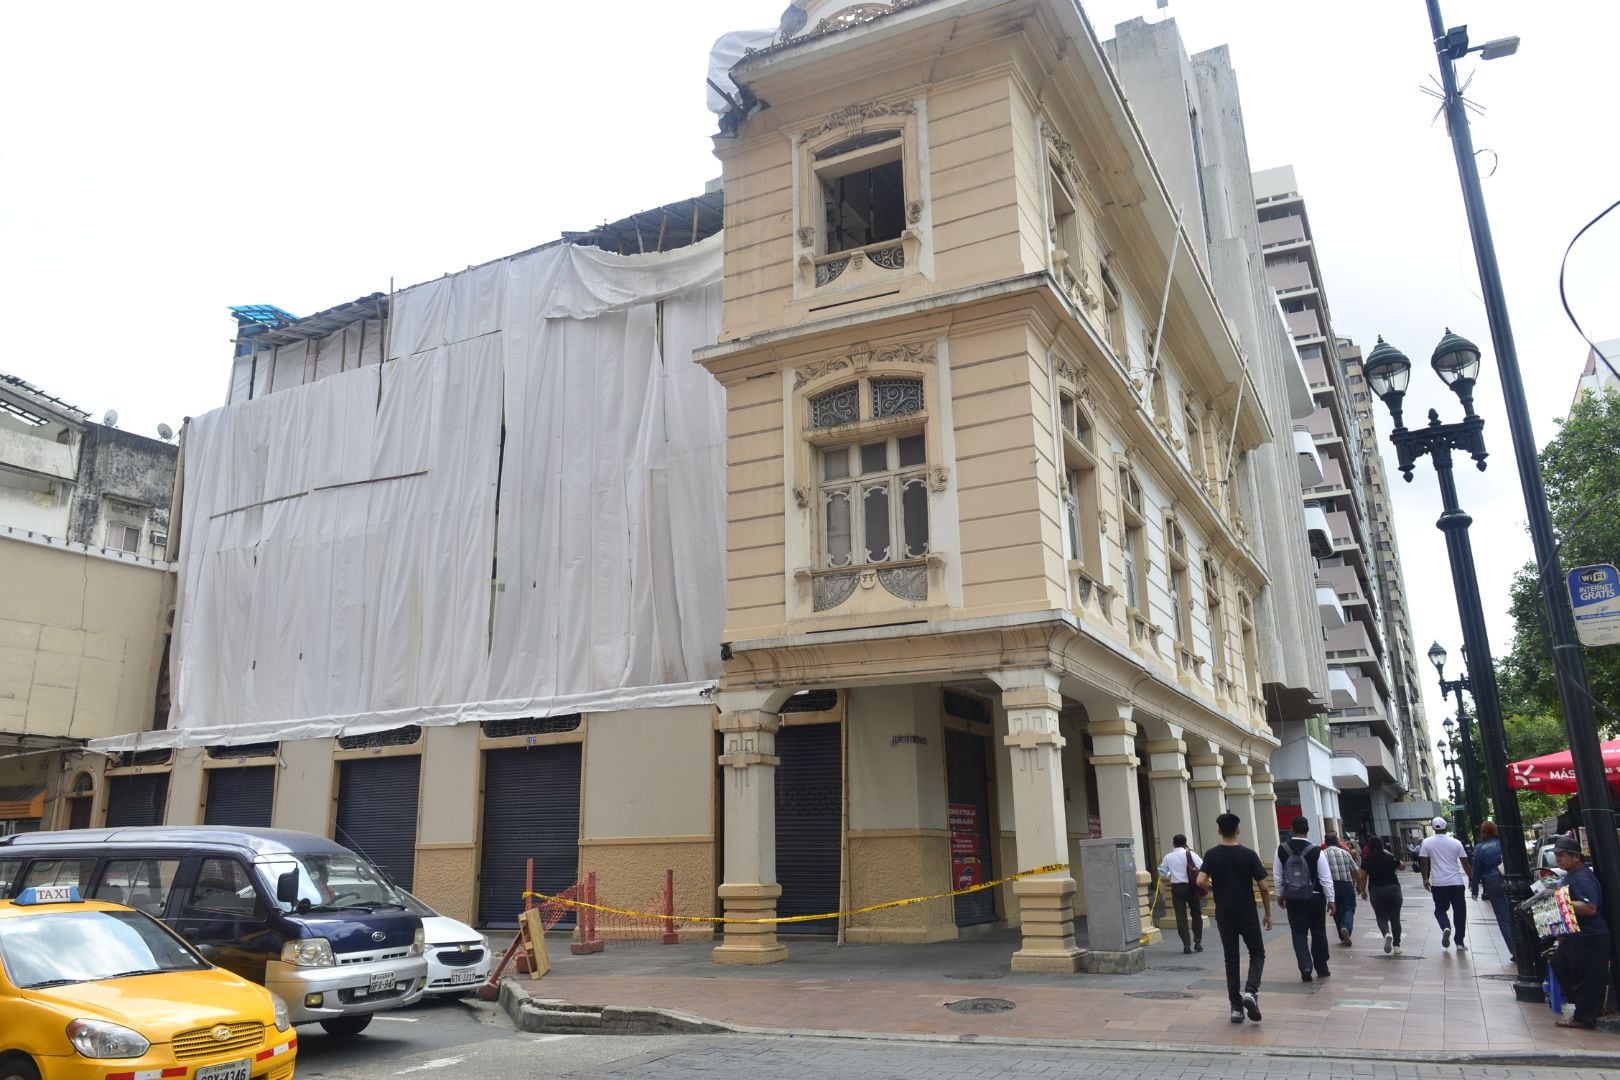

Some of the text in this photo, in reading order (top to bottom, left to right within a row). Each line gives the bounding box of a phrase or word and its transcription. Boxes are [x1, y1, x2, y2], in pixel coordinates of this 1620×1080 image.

[1579, 583, 1613, 594] INTERNET
[1580, 590, 1617, 601] GRATIS
[1549, 767, 1576, 780] MÁS
[37, 888, 69, 900] TAXI
